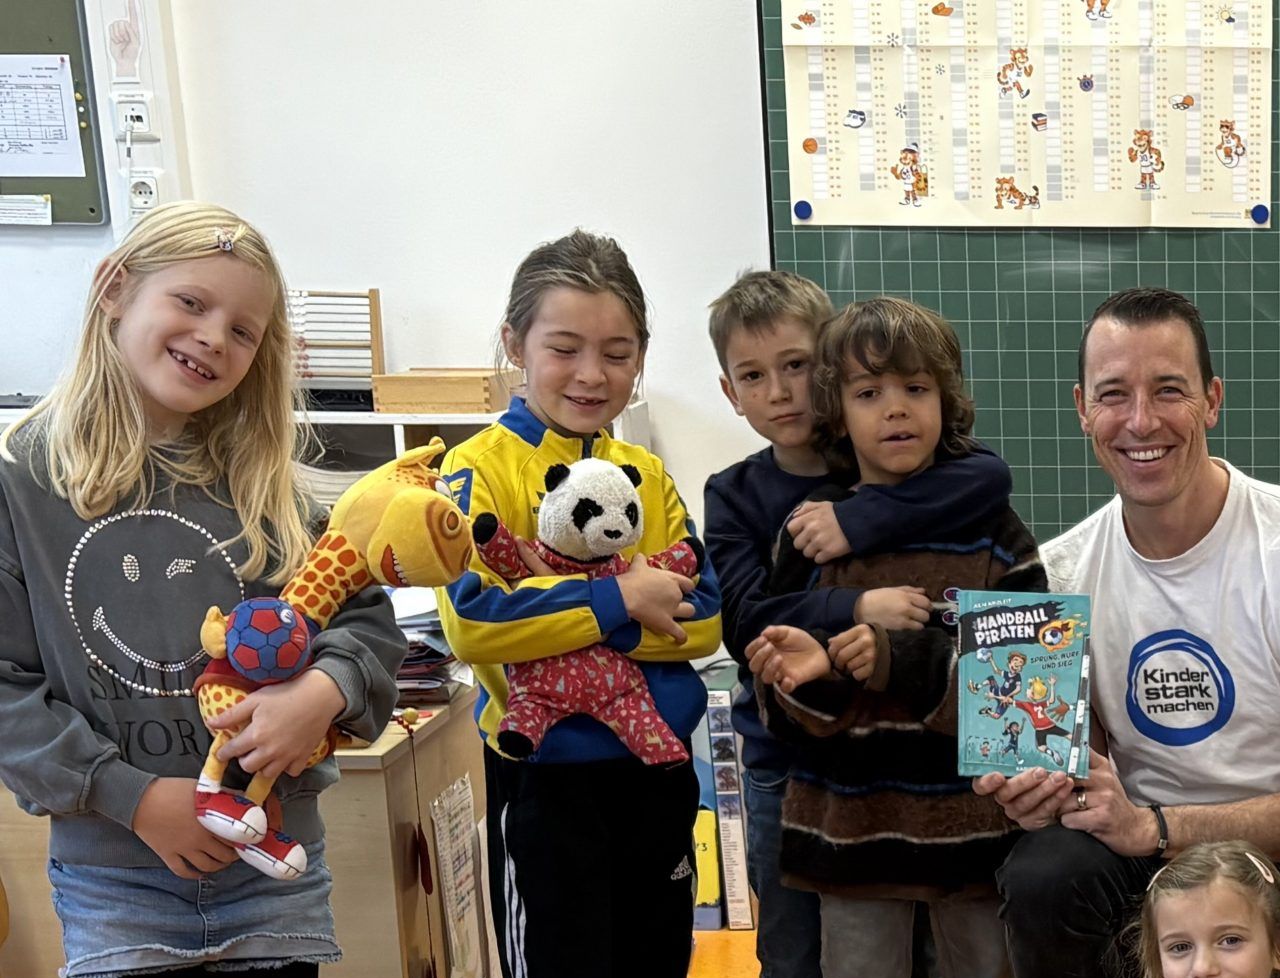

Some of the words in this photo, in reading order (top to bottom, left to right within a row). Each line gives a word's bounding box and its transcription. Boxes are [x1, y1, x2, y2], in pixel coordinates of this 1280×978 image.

[976, 608, 1048, 631] HANDBALL
[1143, 667, 1209, 684] Kinder
[1145, 684, 1212, 700] stark
[1147, 699, 1215, 714] machen
